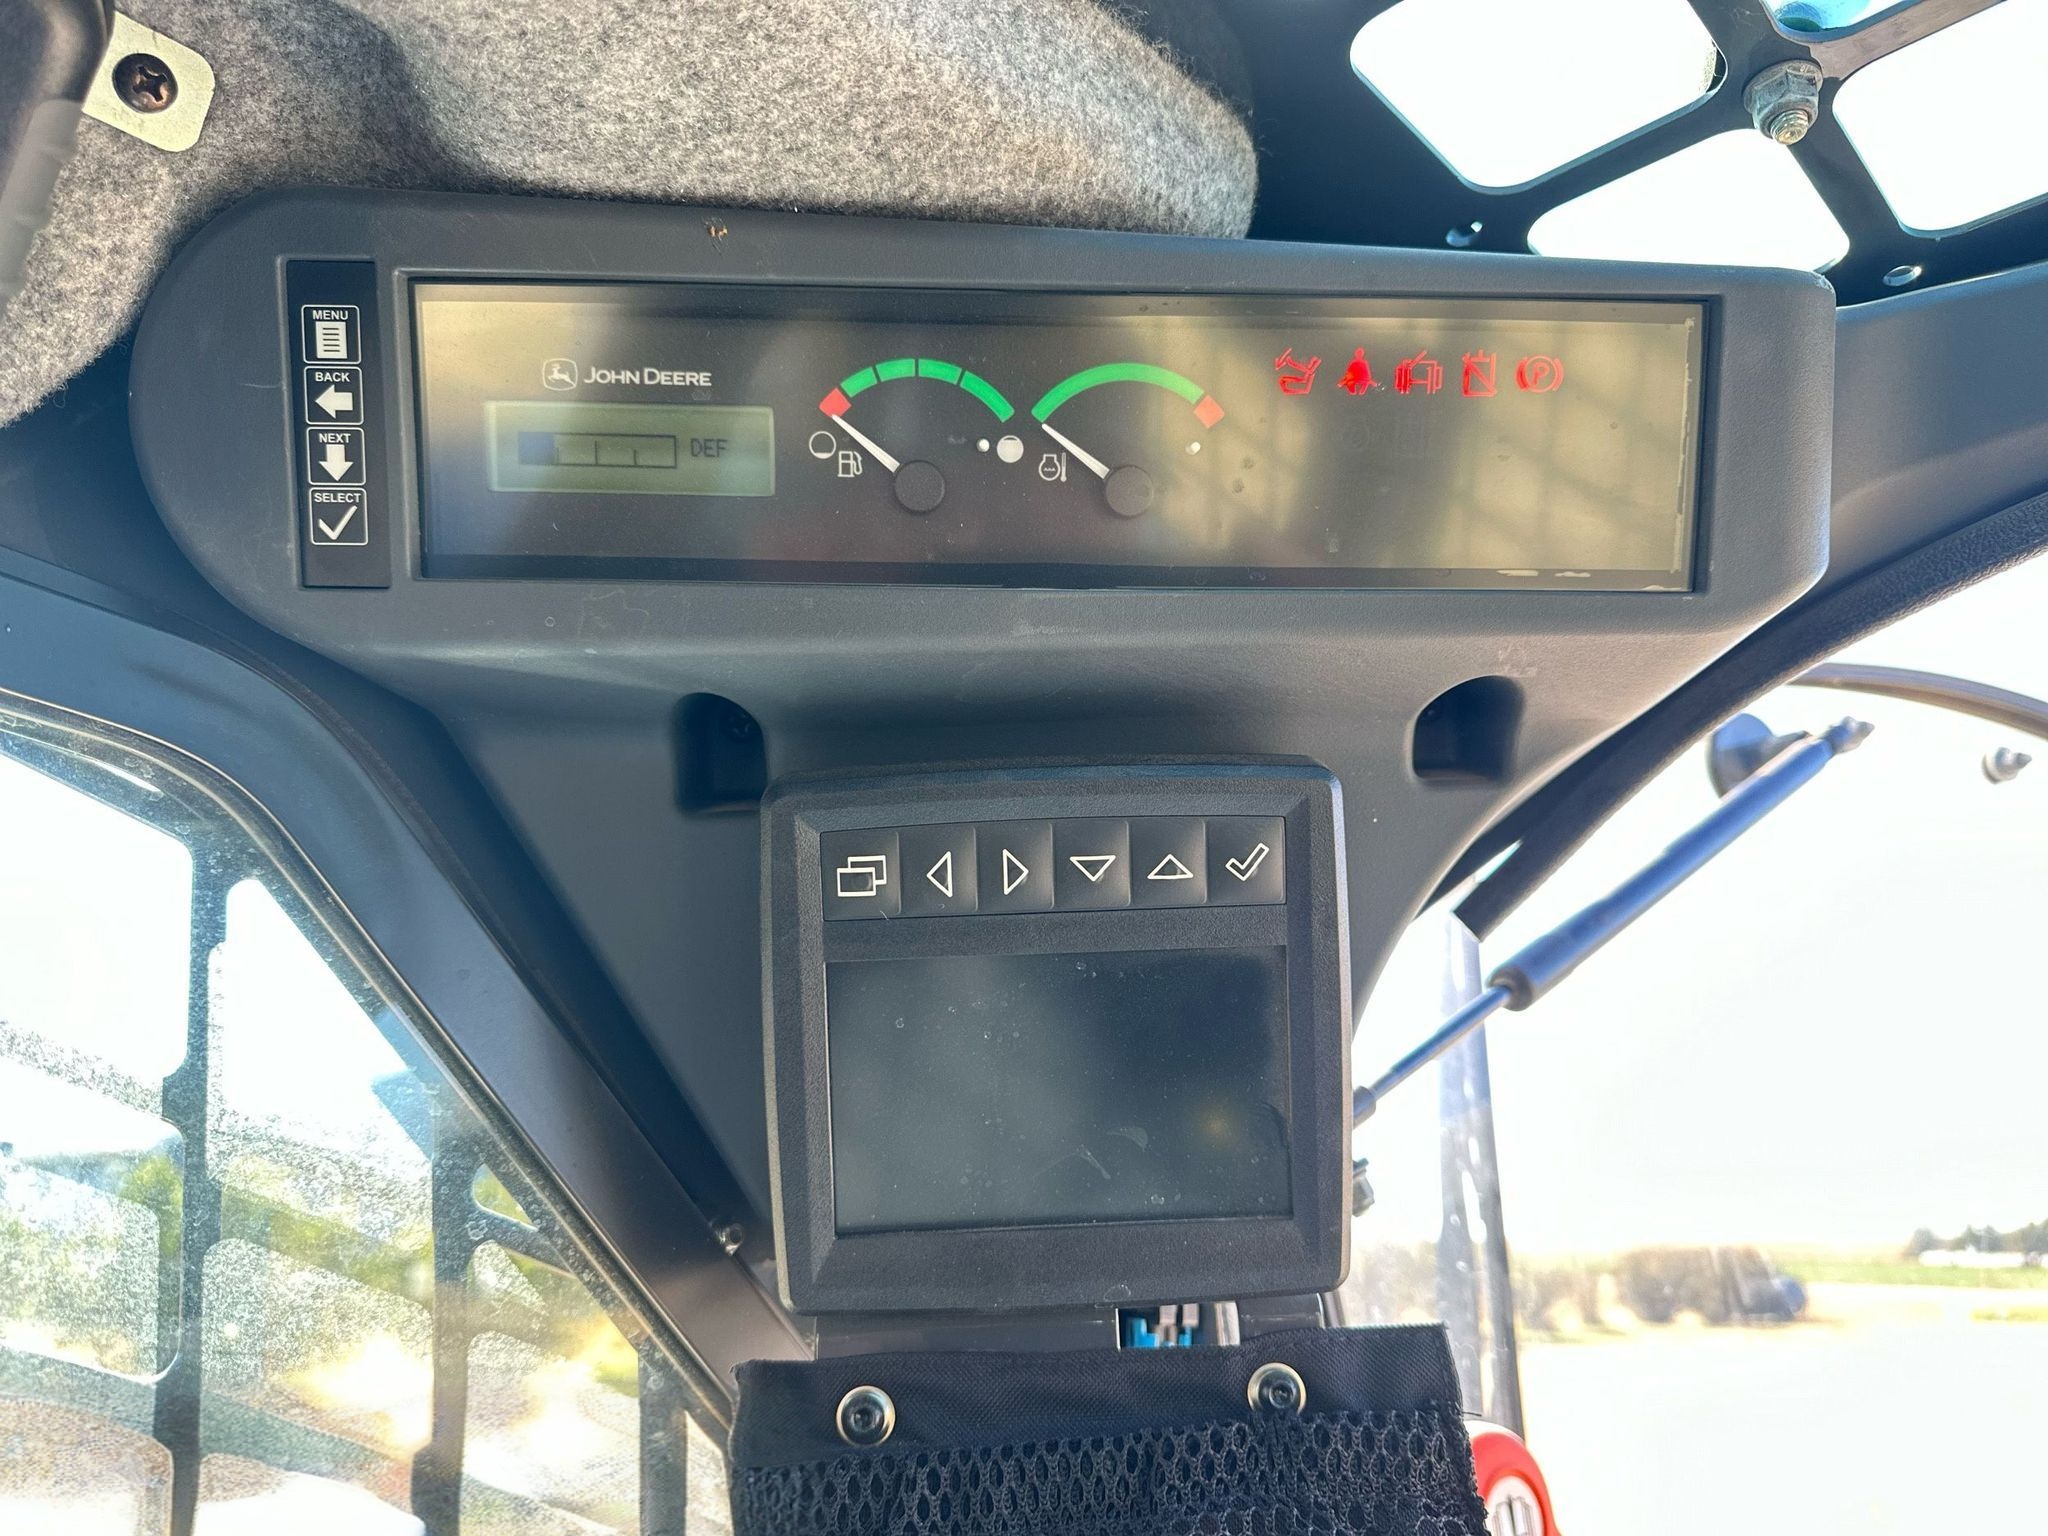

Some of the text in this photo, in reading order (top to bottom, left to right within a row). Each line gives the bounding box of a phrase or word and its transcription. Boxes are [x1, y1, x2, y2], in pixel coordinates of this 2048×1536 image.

[312, 310, 349, 321] MENU
[315, 372, 351, 383] BACK
[584, 366, 712, 387] JOHN DEERE
[318, 433, 352, 443] NEXT
[690, 437, 728, 458] DEF
[314, 493, 362, 504] SELECT
